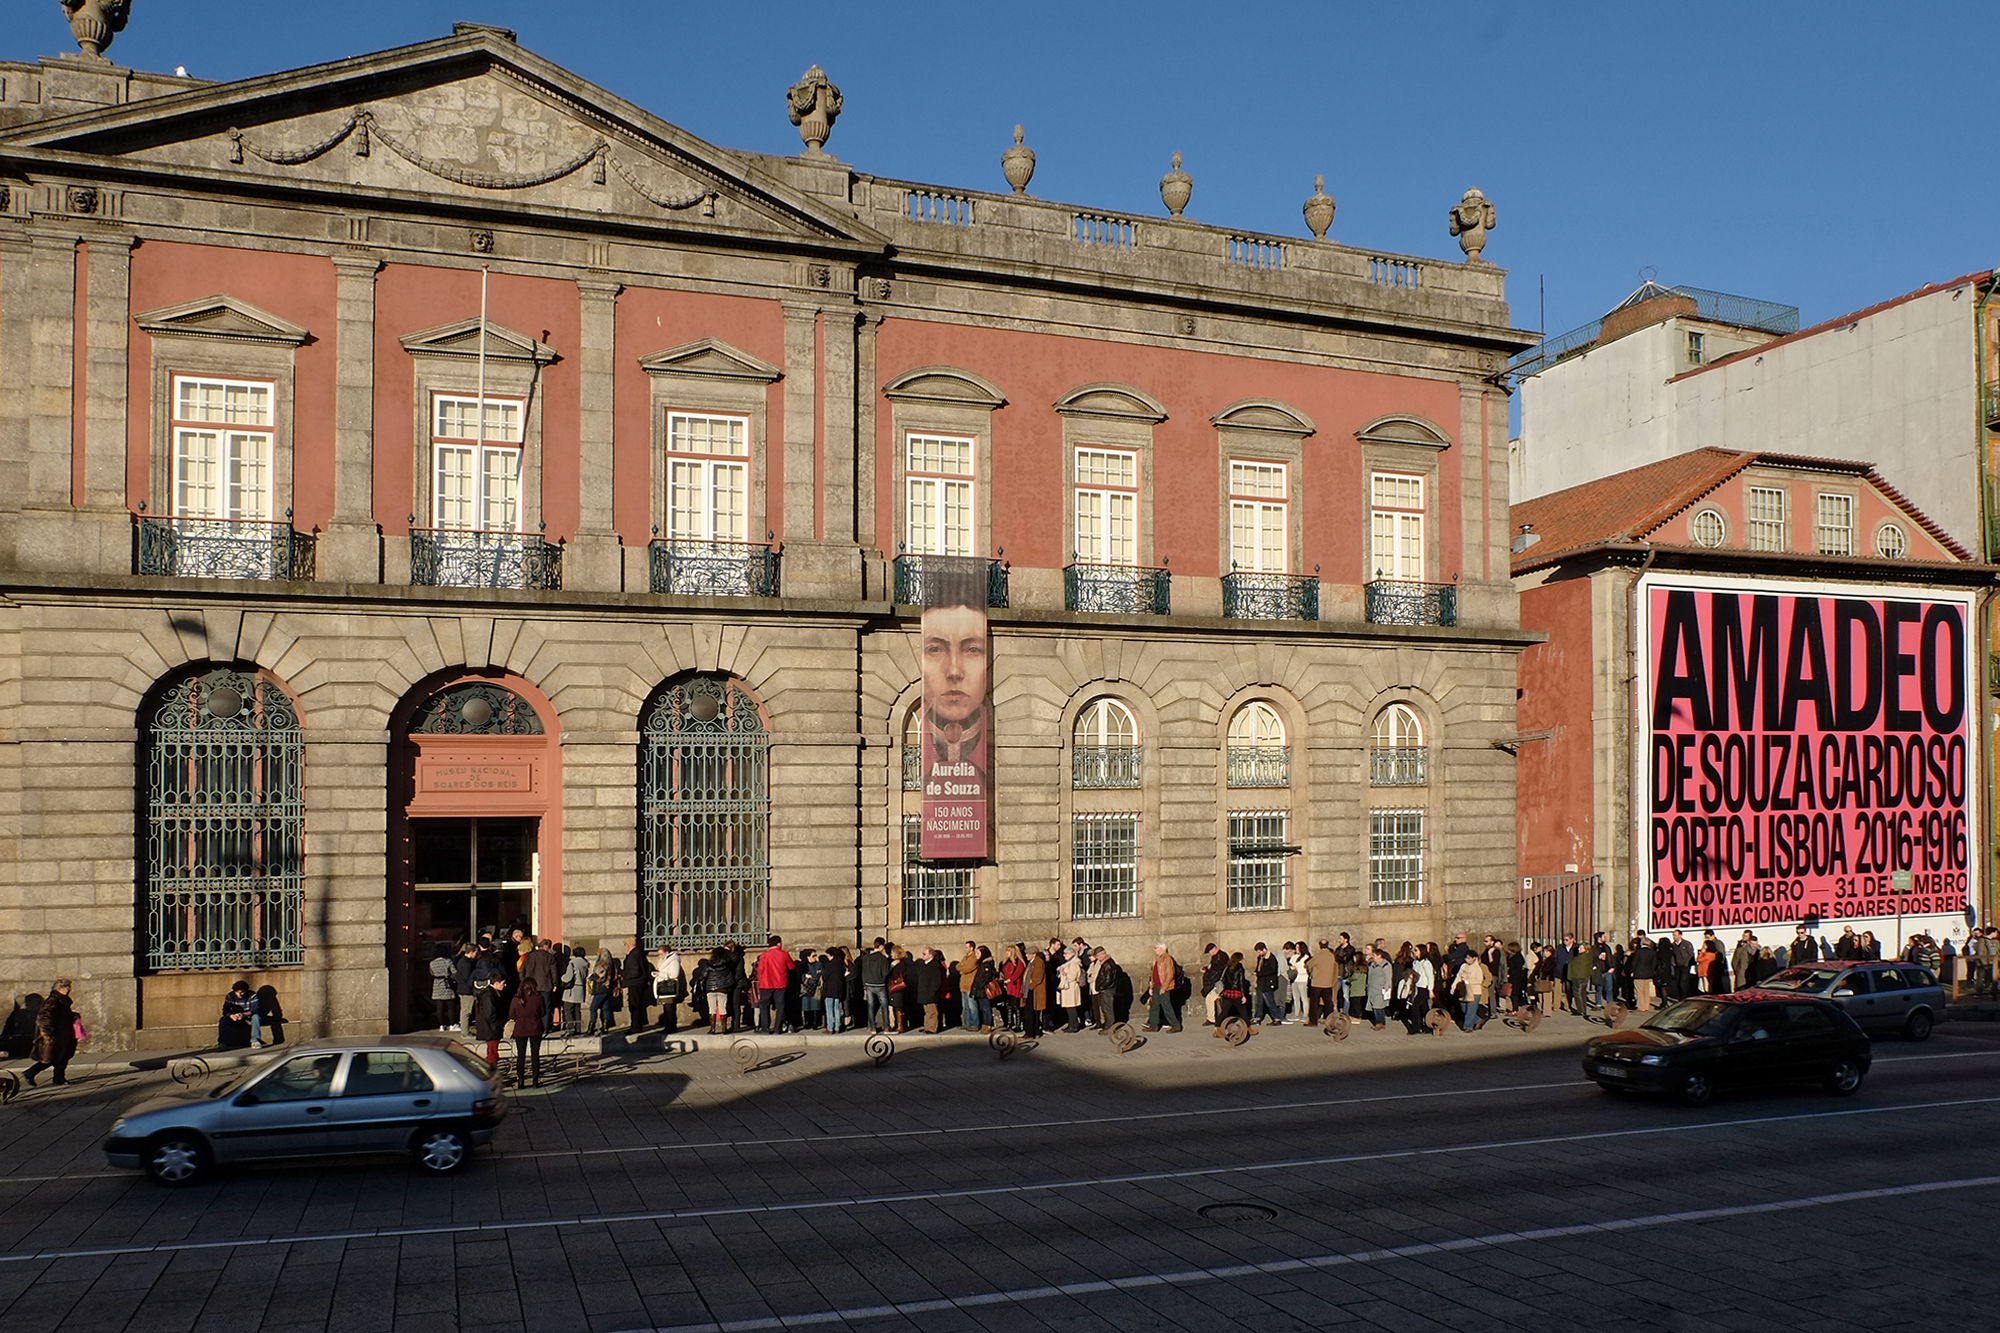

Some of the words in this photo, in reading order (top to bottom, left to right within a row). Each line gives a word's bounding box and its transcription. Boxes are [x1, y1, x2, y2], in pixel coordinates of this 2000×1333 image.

[1653, 590, 1966, 734] AMADEO
[436, 767, 467, 777] MUSEU
[470, 767, 516, 777] NACIONAL
[931, 762, 976, 777] Aurélia
[926, 781, 942, 796] de
[944, 781, 980, 796] Souza
[934, 806, 949, 818] 150
[950, 806, 973, 818] ANOS
[926, 820, 981, 831] NASCIMENTO
[1652, 812, 1848, 884] PORTO-LISBOA
[1854, 809, 1968, 874] 2016-1916
[1652, 885, 1678, 909] 01
[1684, 879, 1805, 907] NOVEMBRO
[1834, 877, 1858, 899] 31
[1864, 872, 1968, 897] DEMBRO
[1652, 909, 1714, 930] MUSEU
[1719, 904, 1804, 926] NACIONAL
[1808, 902, 1830, 920] DE
[1833, 899, 1896, 919] SOARES
[1901, 897, 1932, 916] DOS
[1935, 895, 1968, 914] REIS
